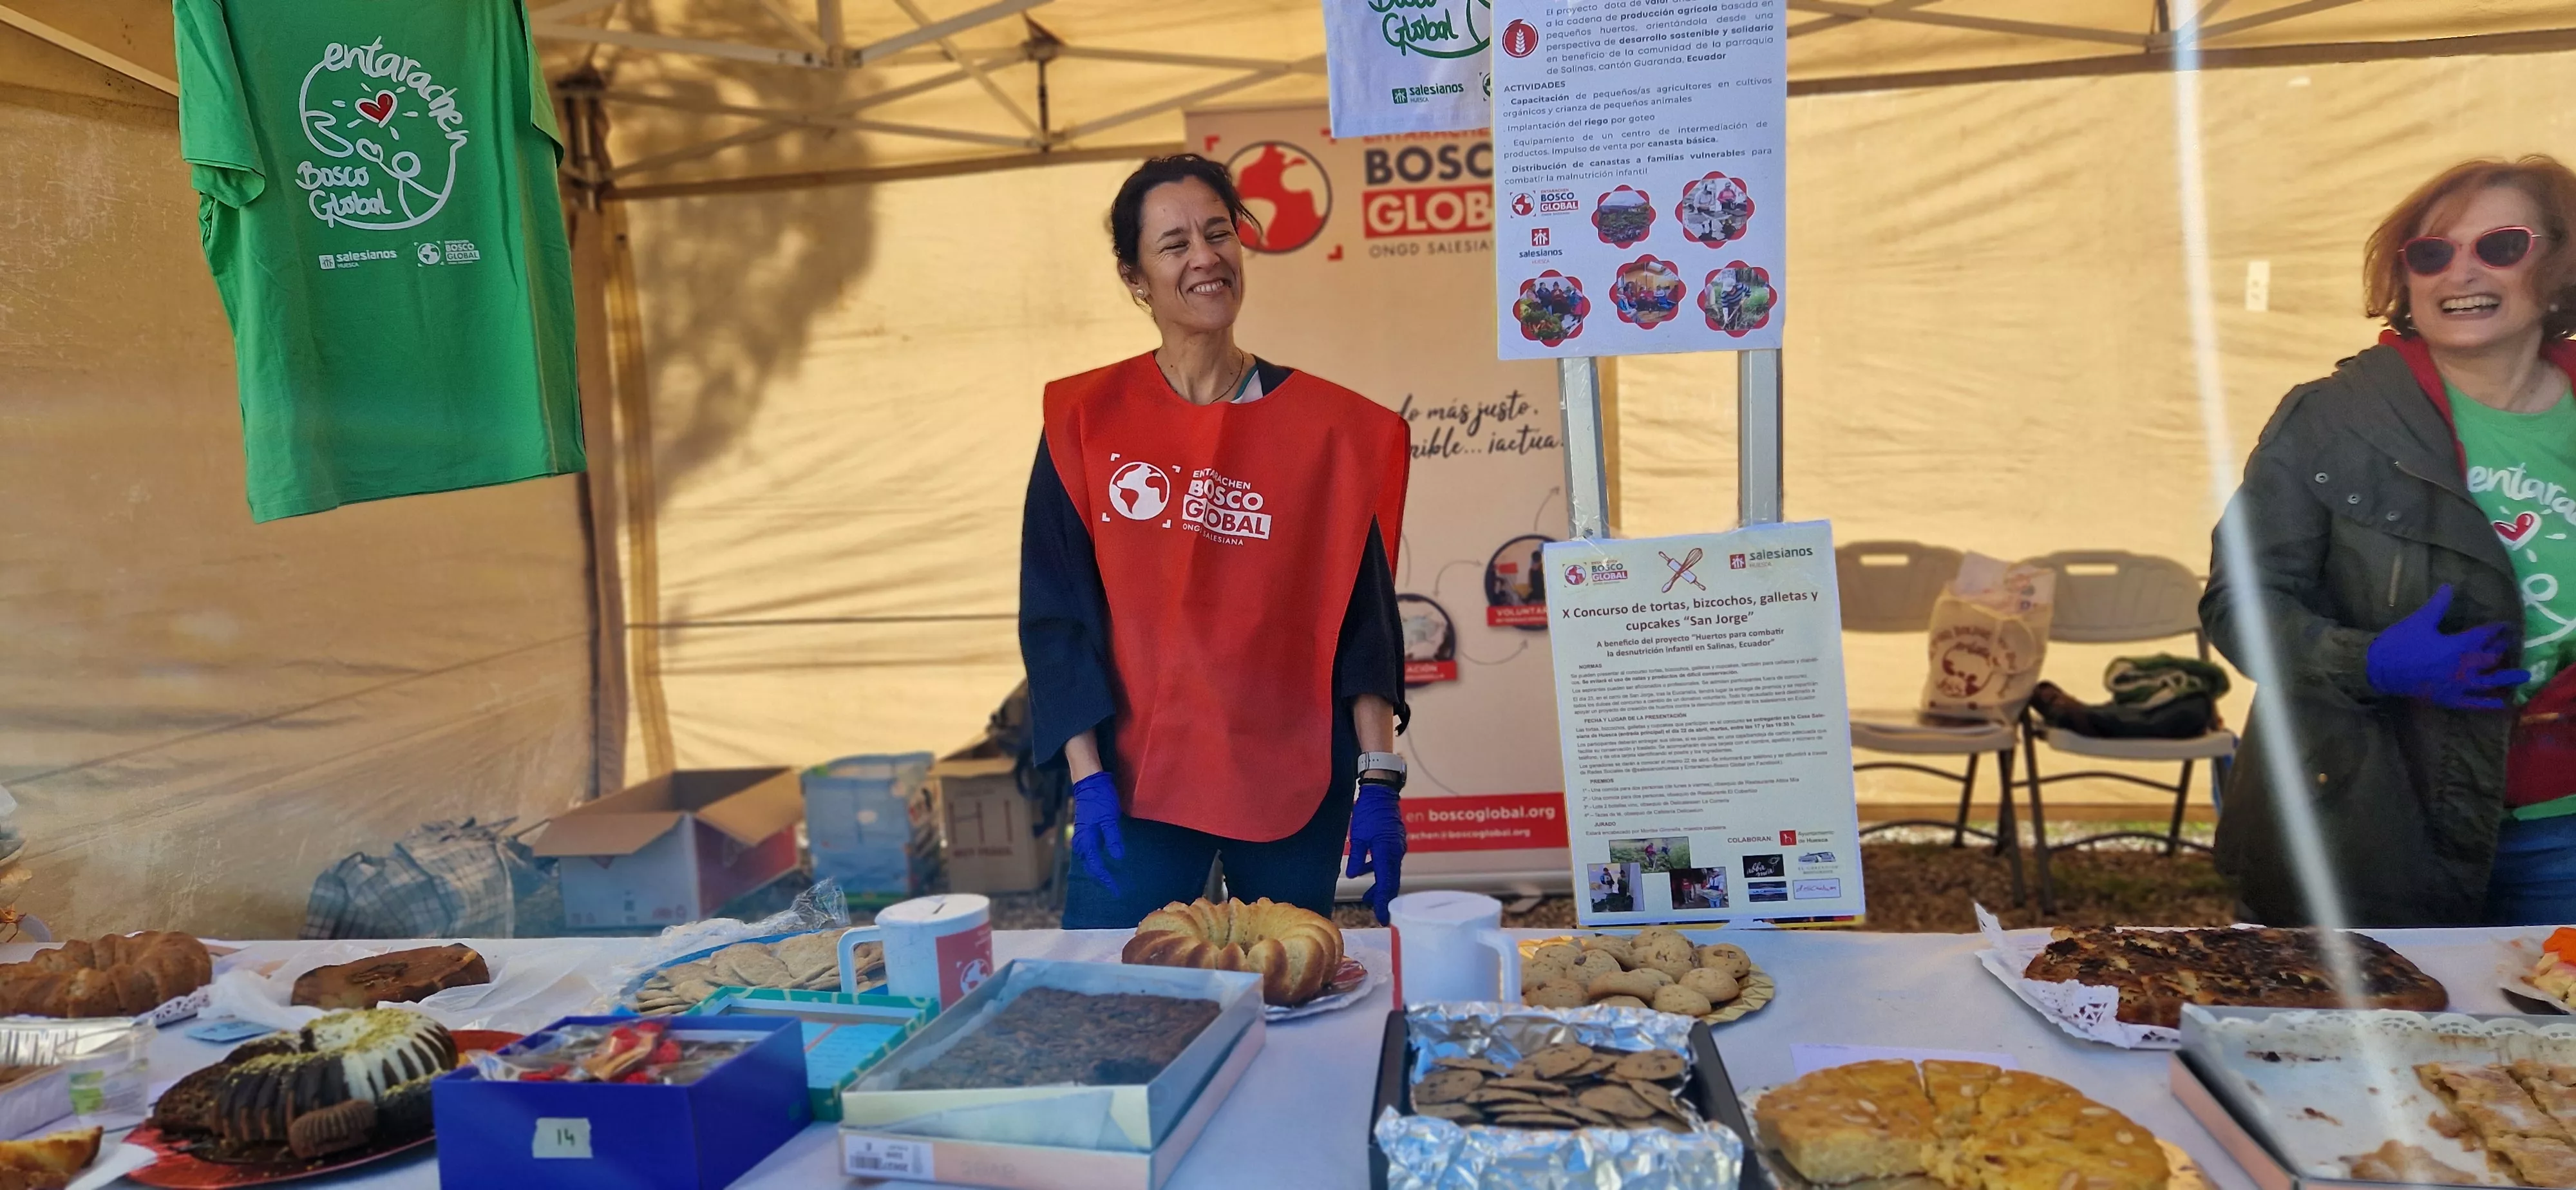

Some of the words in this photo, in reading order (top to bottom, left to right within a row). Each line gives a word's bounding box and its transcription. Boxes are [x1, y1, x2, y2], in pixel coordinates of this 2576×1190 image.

[1556, 5, 1598, 17] proyecto
[1604, 1, 1626, 10] dota
[1567, 16, 1602, 24] cadena
[1621, 8, 1674, 21] producción
[1678, 5, 1717, 15] agrícola
[1721, 1, 1757, 10] basada
[1383, 8, 1459, 56] Global
[1546, 29, 1591, 41] pequeños
[1600, 25, 1637, 33] huertos,
[1646, 18, 1707, 30] orientándola
[1717, 14, 1745, 23] desde
[1547, 41, 1600, 52] perspectiva
[1620, 33, 1667, 44] desarrollo
[1671, 28, 1719, 39] sostenible
[1732, 24, 1773, 33] solidario
[1562, 51, 1604, 61] beneficio
[1638, 42, 1690, 55] comunidad
[1561, 65, 1596, 73] Salinas,
[1598, 61, 1631, 70] cantón
[1634, 57, 1684, 66] Guaranda,
[1687, 53, 1726, 62] Ecuador
[325, 36, 469, 149] entarachen
[1410, 83, 1464, 95] salesianos
[1504, 80, 1565, 92] ACTIVIDADES
[1511, 94, 1569, 106] Capacitación
[1593, 86, 1650, 100] pequeños/as
[1657, 83, 1711, 93] agricultores
[1503, 108, 1546, 118] orgánicos
[1604, 100, 1648, 111] pequeños
[1651, 95, 1692, 105] animales
[1508, 121, 1565, 132] Implantación
[1585, 118, 1608, 126] riego
[1629, 115, 1654, 124] goteo
[1514, 137, 1574, 147] Equipamiento
[1678, 122, 1747, 133] intermediación
[1504, 150, 1549, 159] productos.
[1553, 146, 1586, 155] Impulso
[1512, 162, 1566, 172] Distribución
[1647, 154, 1683, 162] familias
[1690, 149, 1745, 159] vulnerables
[295, 160, 369, 189] Bosco
[1505, 175, 1544, 184] combatir
[1557, 171, 1613, 180] malnutrición
[1616, 167, 1647, 176] infantil
[1540, 192, 1575, 202] BOSCO
[309, 188, 392, 228] Global
[1541, 202, 1578, 211] GLOBAL
[446, 243, 475, 251] BOSCO
[447, 250, 478, 260] GLOBAL
[1426, 240, 1494, 254] SALESIA
[1519, 249, 1563, 258] salesianos
[336, 250, 397, 263] salesianos
[1427, 397, 1469, 424] más
[1193, 468, 1251, 489] ENTARACHEN
[1188, 478, 1264, 511] BOSCO
[2467, 462, 2576, 527] entara
[1202, 531, 1244, 546] SALESIANA
[1749, 547, 1813, 561] salesianos
[1591, 563, 1624, 572] BOSCO
[1592, 571, 1627, 581] GLOBAL
[1562, 609, 1569, 618] X
[1574, 607, 1628, 618] Concurso
[1632, 603, 1646, 613] de
[1650, 601, 1689, 612] tortas,
[1693, 596, 1756, 608] bizcochos,
[1760, 592, 1807, 605] galletas
[1811, 592, 1817, 601] y
[1626, 618, 1680, 632] cupcakes
[1684, 616, 1712, 625] “San
[1716, 612, 1754, 625] Jorge”
[1604, 639, 1639, 647] beneficio
[1656, 636, 1690, 647] proyecto
[1749, 628, 1784, 636] combatir
[1616, 647, 1663, 656] desnutrición
[1428, 806, 1555, 823] boscoglobal.org
[557, 1128, 575, 1146] 14
